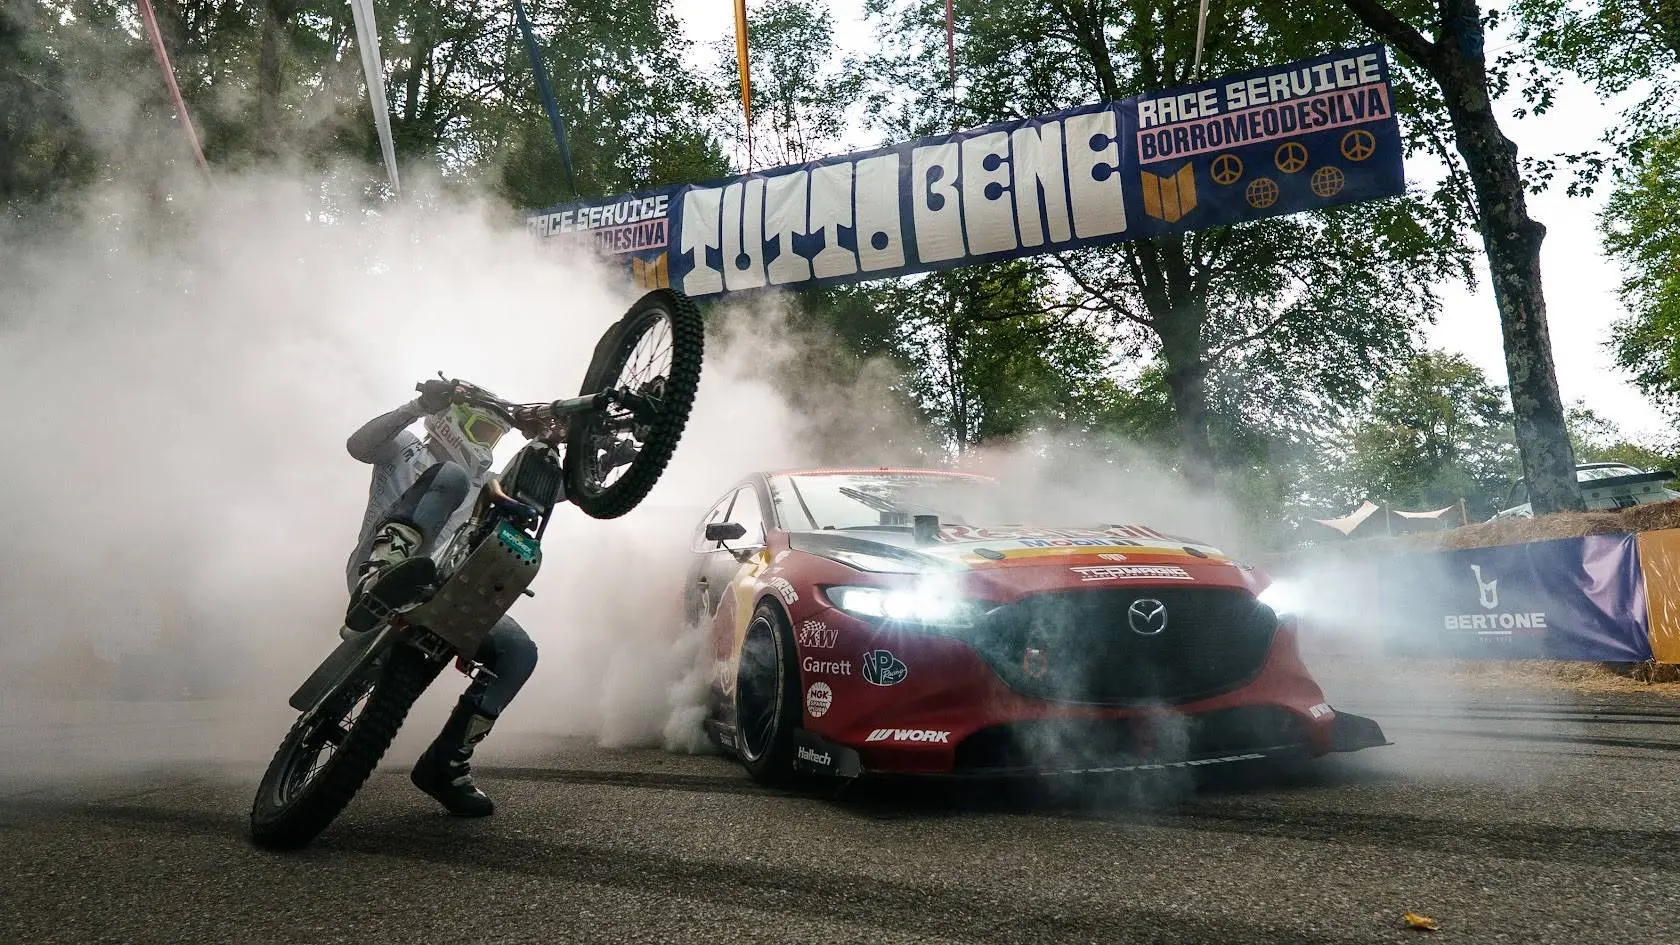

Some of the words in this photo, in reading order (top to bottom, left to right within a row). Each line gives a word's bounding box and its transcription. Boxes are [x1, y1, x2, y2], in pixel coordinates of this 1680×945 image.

[1138, 88, 1219, 129] RACE
[1226, 53, 1381, 111] SERVICE
[1141, 88, 1386, 160] BORROMEODESILVA
[681, 153, 905, 297] TUTTO
[912, 103, 1127, 264] BENE
[577, 195, 669, 230] SERVICE
[1019, 539, 1110, 548] Mobil
[1444, 612, 1547, 630] BERTONE
[803, 629, 839, 649] KW
[802, 656, 852, 676] Garrett
[863, 650, 894, 686] VP
[810, 690, 829, 700] NGK
[893, 729, 952, 744] WORK
[797, 746, 832, 766] Haltech
